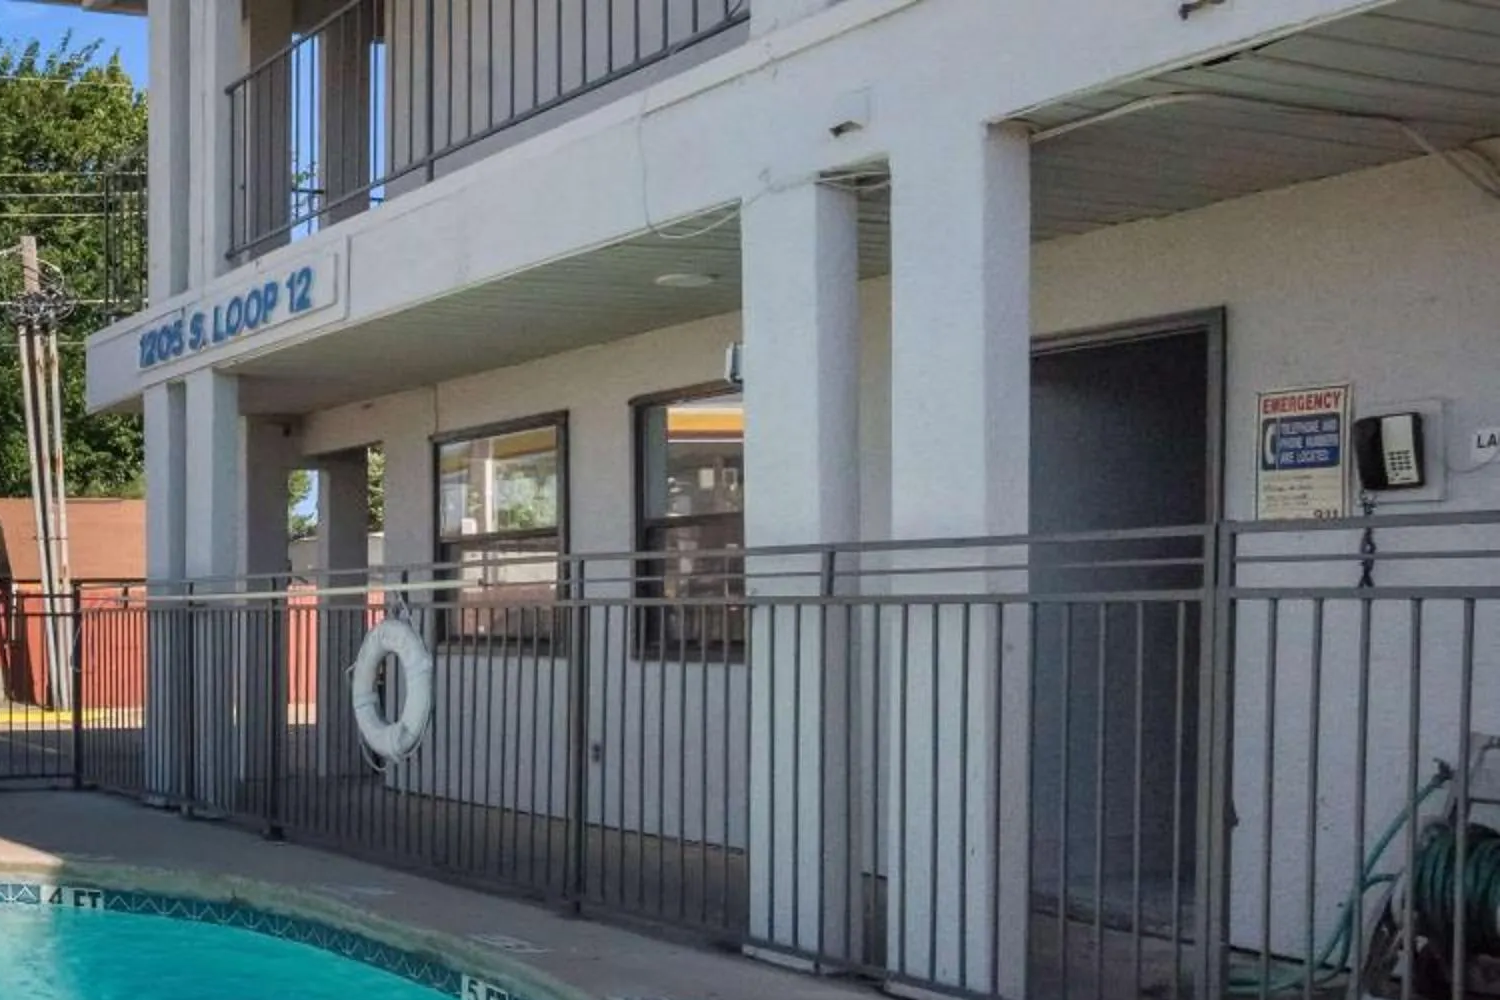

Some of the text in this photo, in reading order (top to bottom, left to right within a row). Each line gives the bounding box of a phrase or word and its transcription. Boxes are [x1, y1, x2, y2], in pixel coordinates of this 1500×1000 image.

[139, 318, 184, 369] 1205
[212, 281, 279, 343] LOOP
[286, 266, 313, 313] 12
[1263, 391, 1341, 414] EMERGENCY
[49, 887, 63, 905] 4
